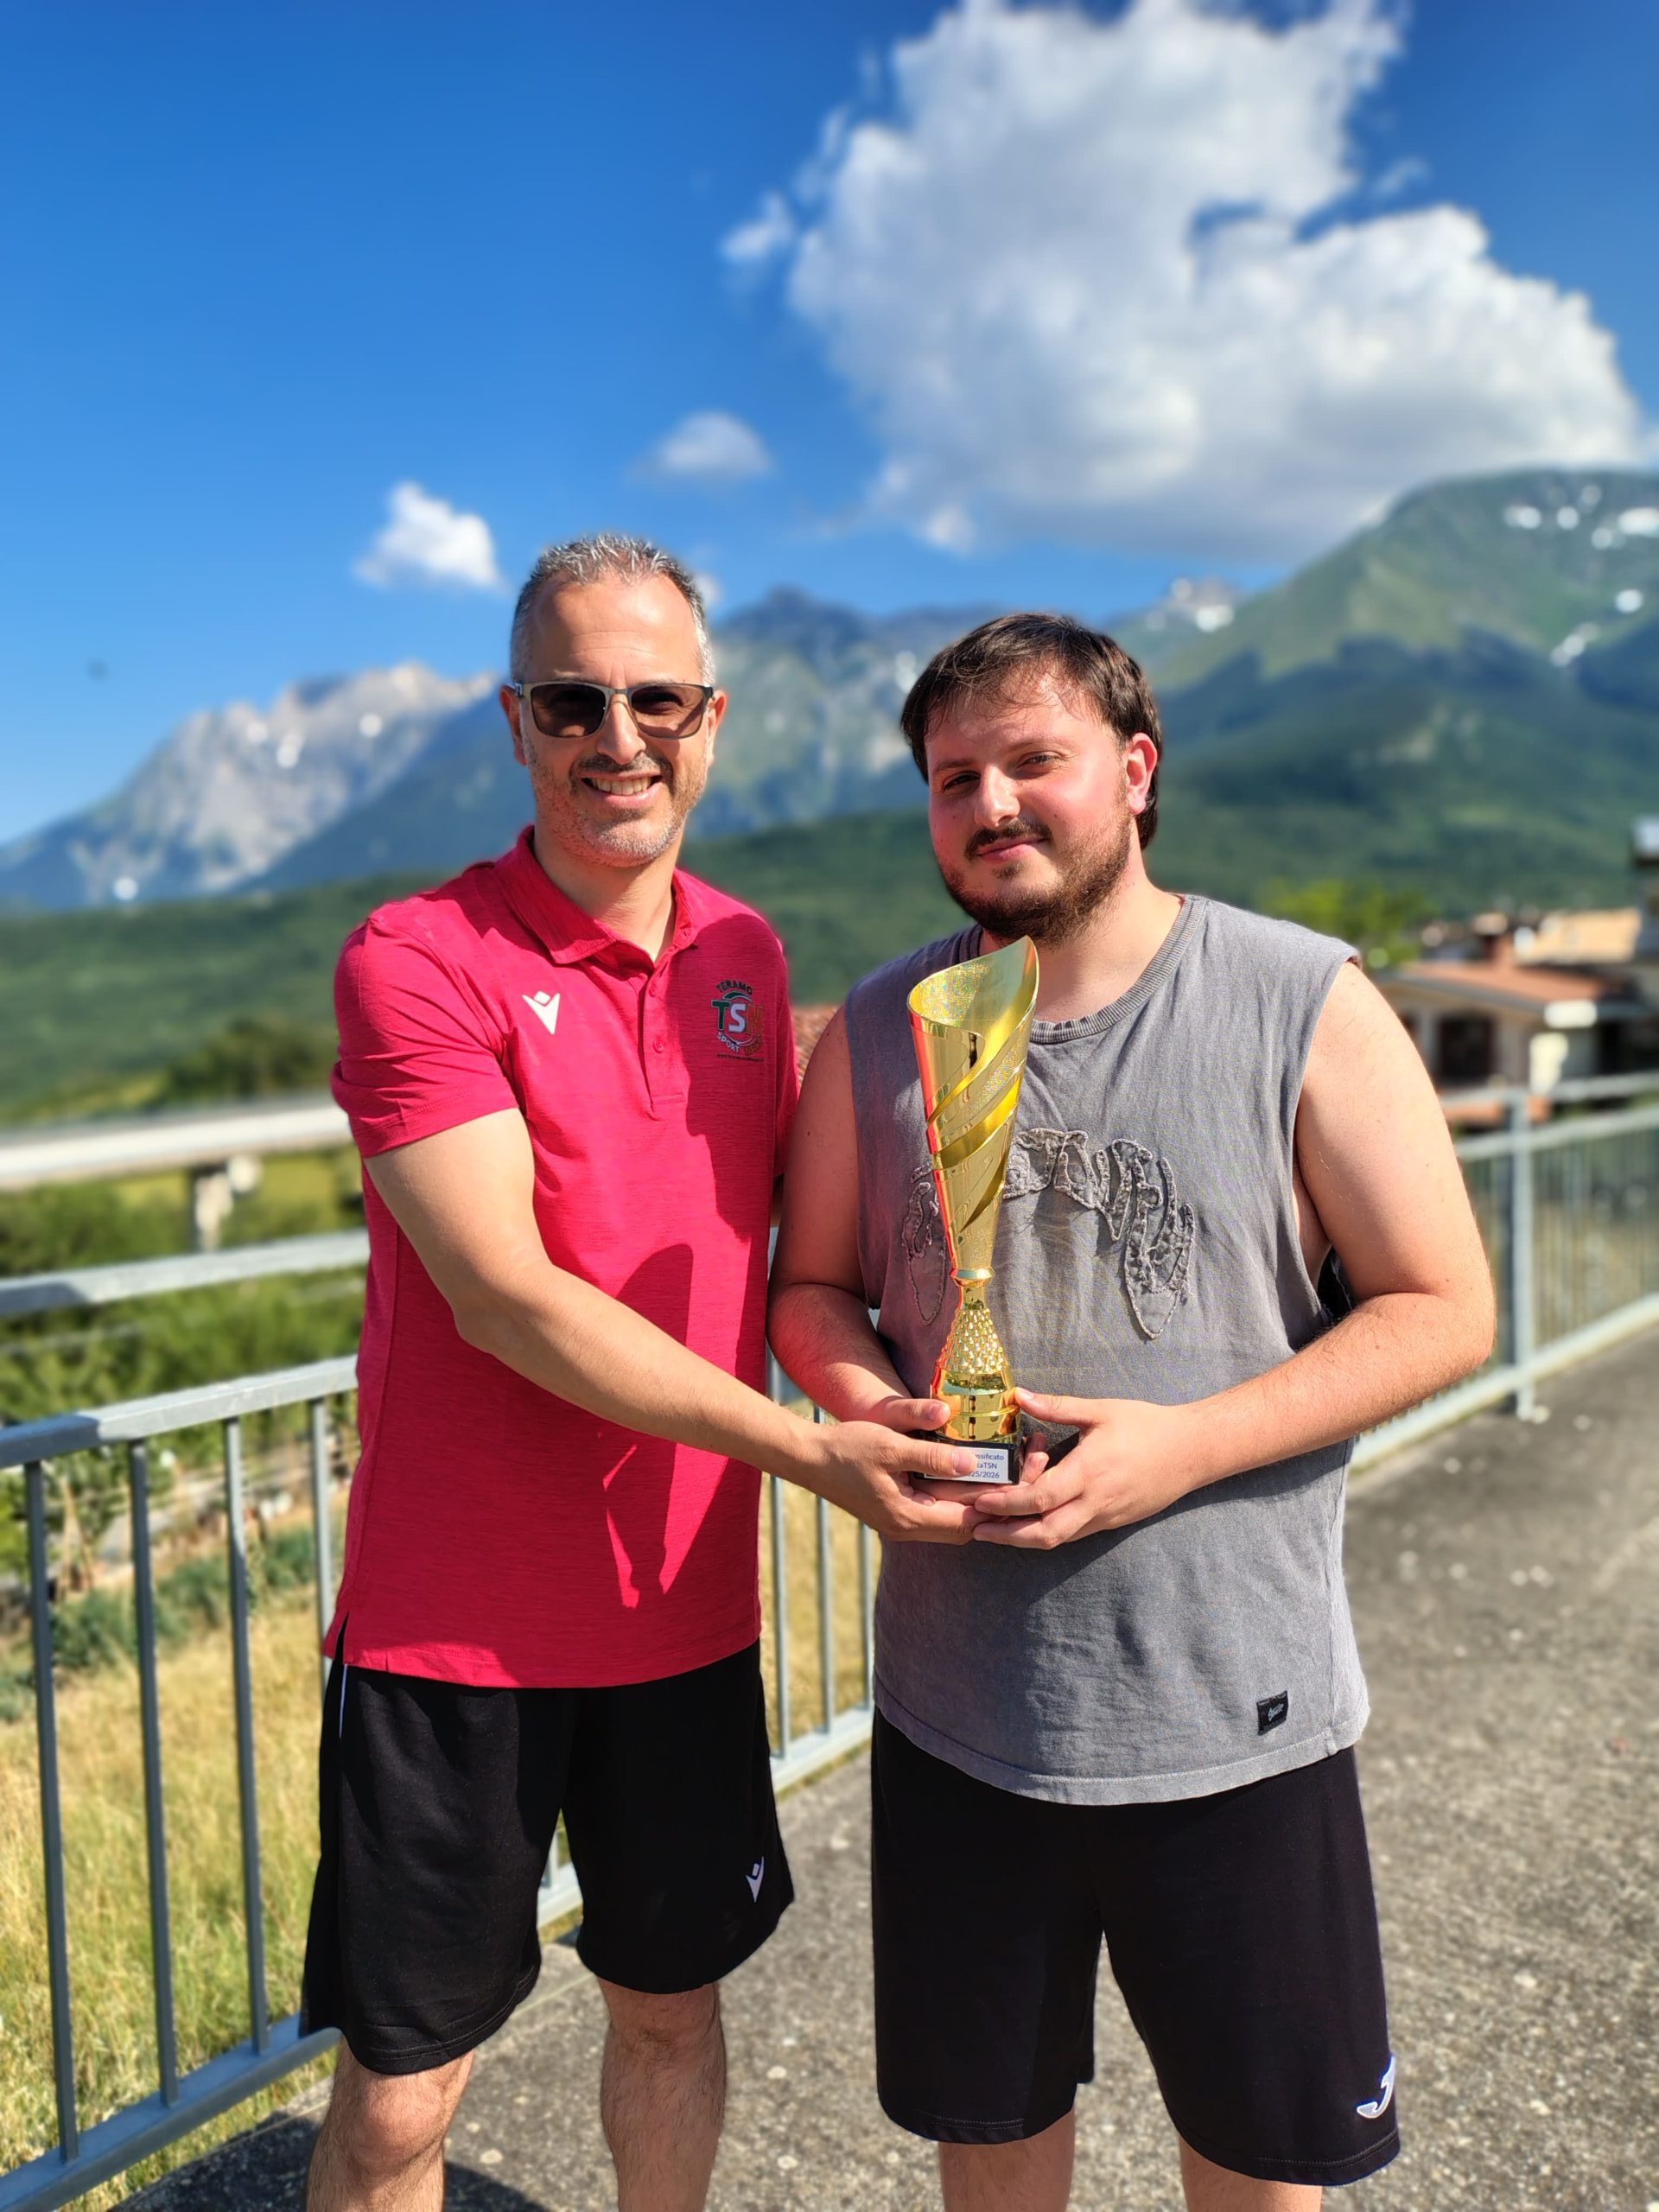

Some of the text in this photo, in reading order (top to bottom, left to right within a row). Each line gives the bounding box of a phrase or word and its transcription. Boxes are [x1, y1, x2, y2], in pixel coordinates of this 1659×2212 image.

[715, 979, 753, 995] TERAMO
[717, 1032, 740, 1053] SPORT
[969, 1470, 1000, 1478] 25/2026
